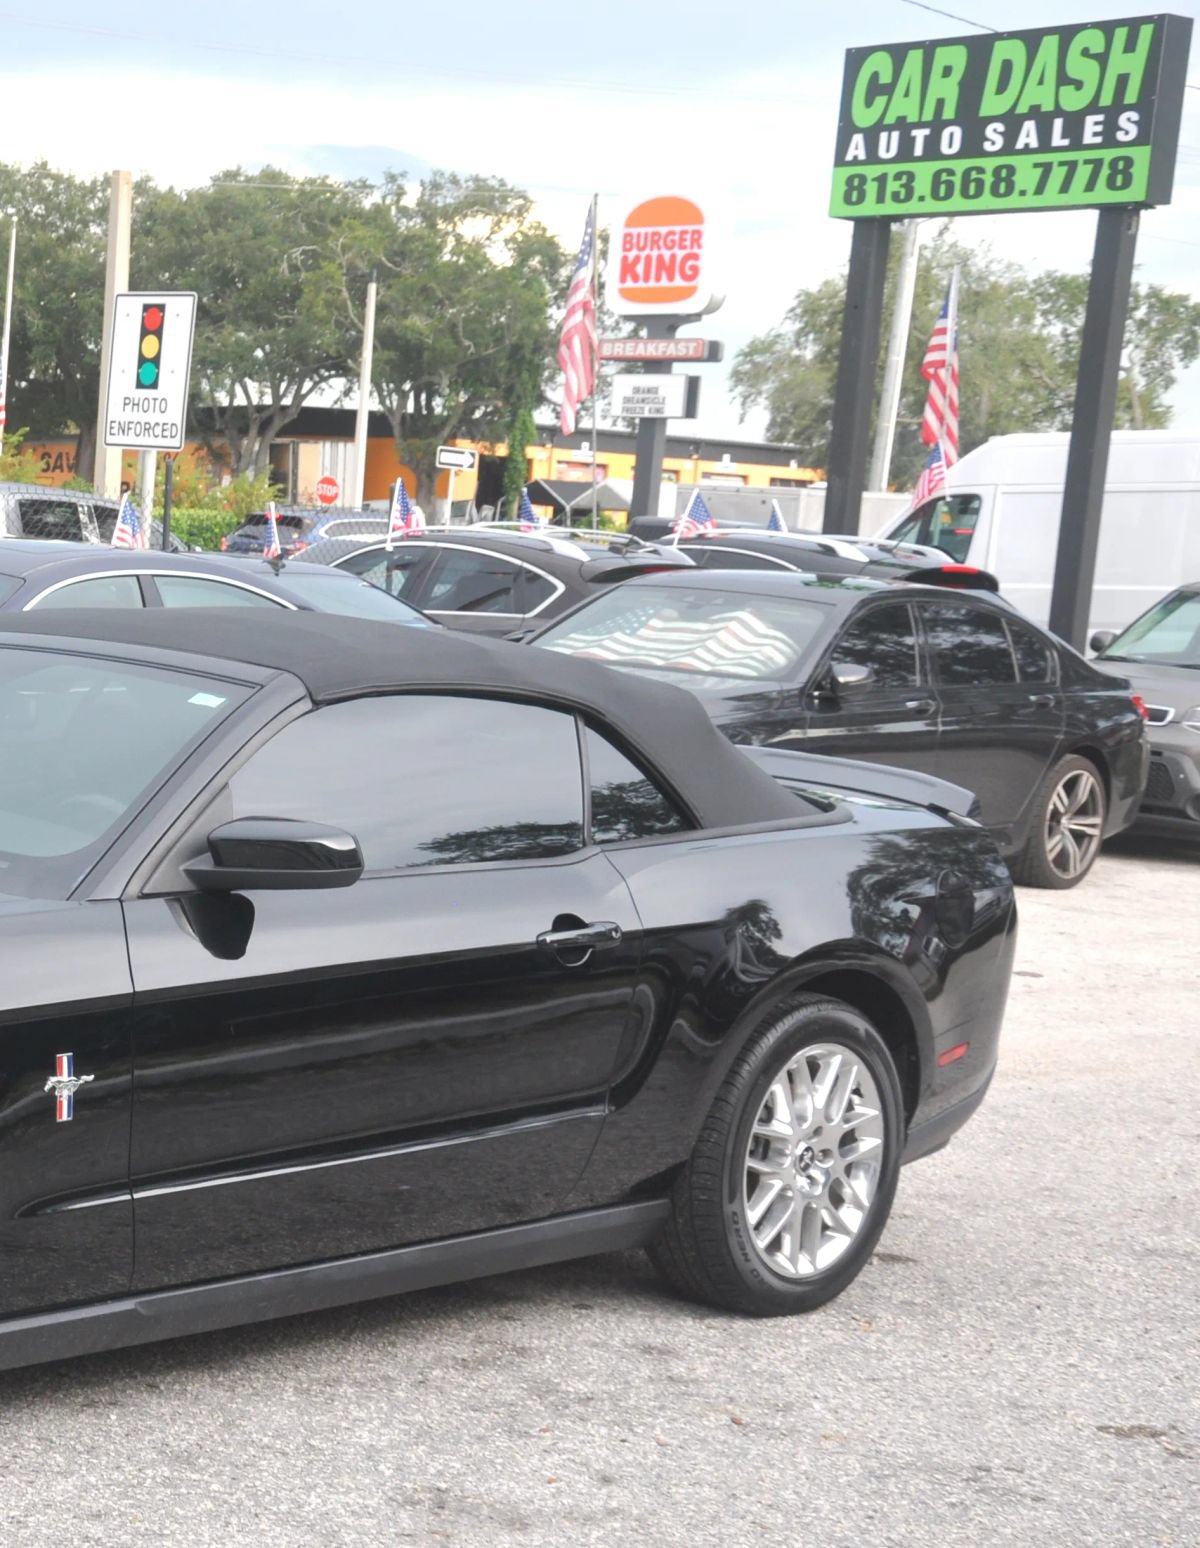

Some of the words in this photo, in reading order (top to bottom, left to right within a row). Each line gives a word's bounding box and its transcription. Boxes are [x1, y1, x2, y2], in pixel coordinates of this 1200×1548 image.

[851, 45, 968, 128] CAR
[978, 23, 1155, 117] DASH
[845, 125, 963, 162] AUTO
[983, 111, 1140, 152] SALES
[843, 155, 1135, 206] 813.668.7778
[622, 229, 704, 253] BURGER
[619, 252, 701, 284] KING
[602, 341, 697, 356] BREAKFAST
[122, 397, 168, 414] PHOTO
[108, 420, 179, 439] ENFORCED
[316, 483, 339, 497] STOP
